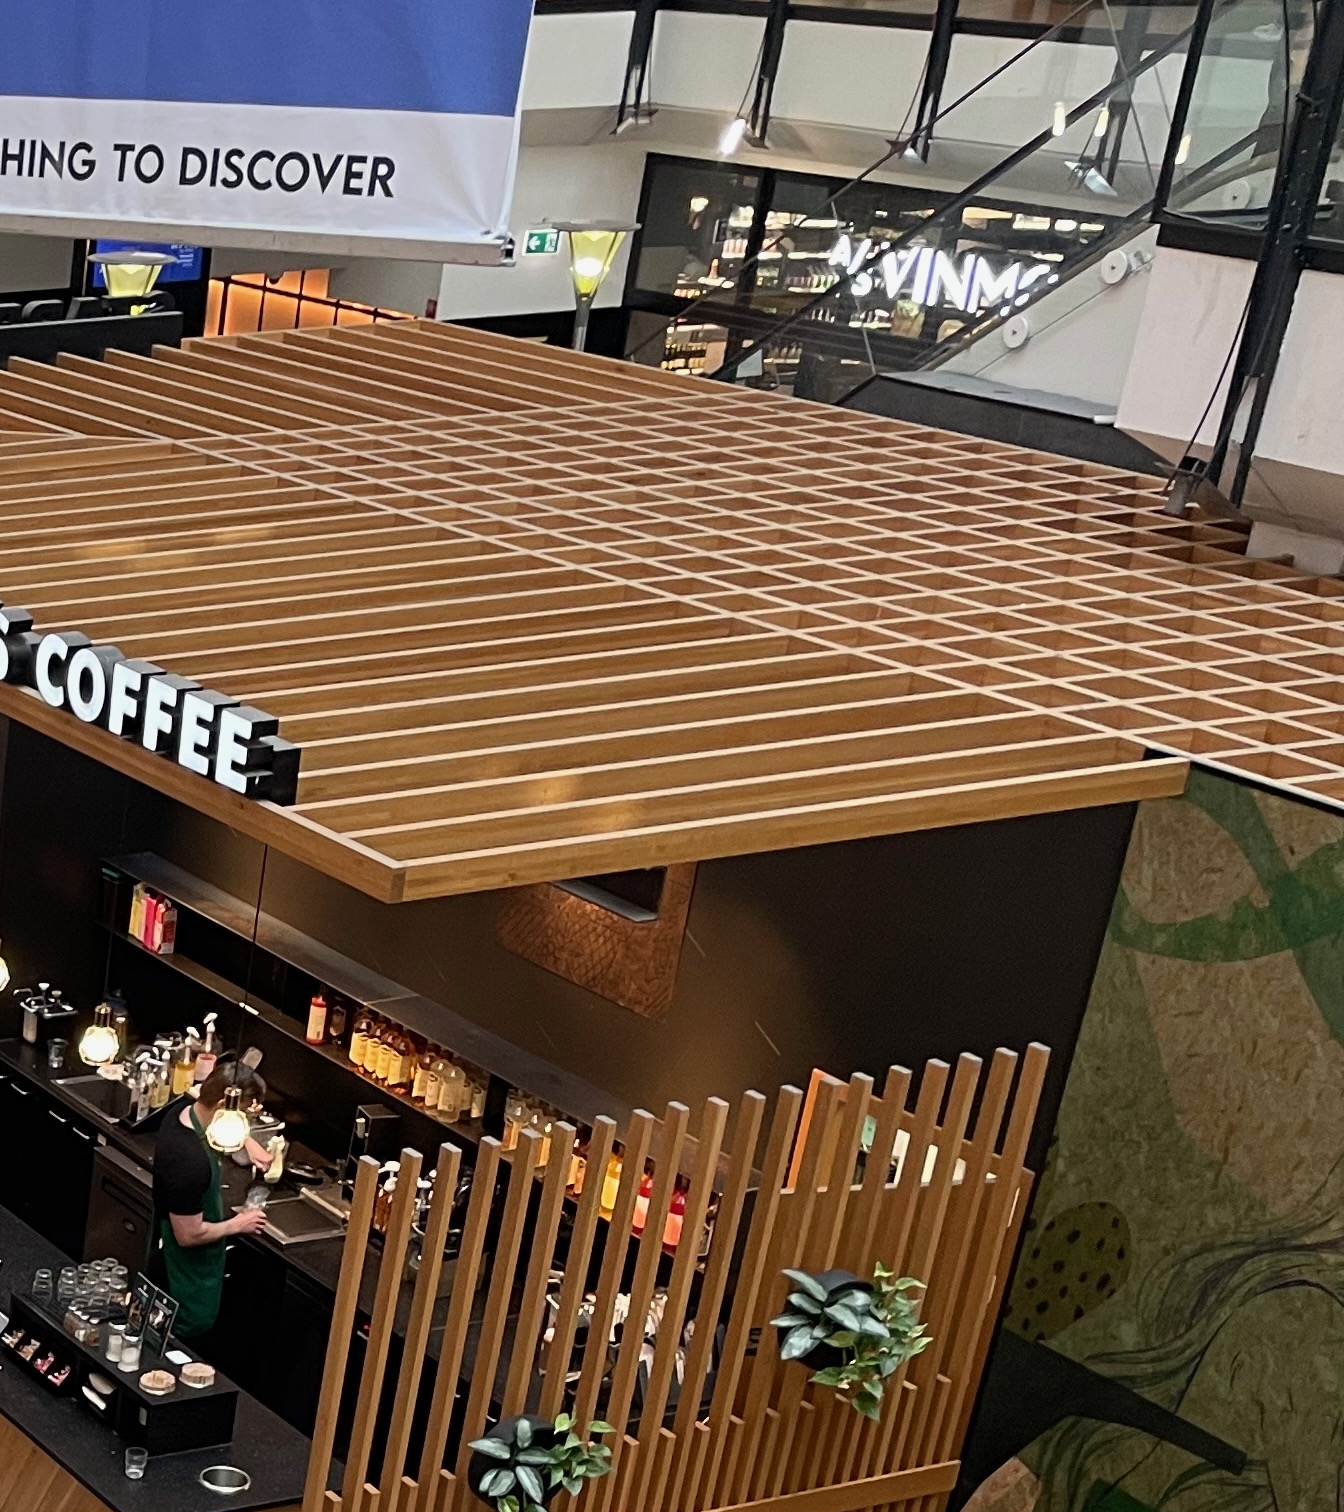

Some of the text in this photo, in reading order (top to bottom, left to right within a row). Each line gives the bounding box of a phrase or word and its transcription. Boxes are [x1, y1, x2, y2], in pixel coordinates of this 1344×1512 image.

[113, 142, 165, 185] TO
[179, 147, 397, 199] DISCOVER
[35, 632, 255, 795] COFFEE
